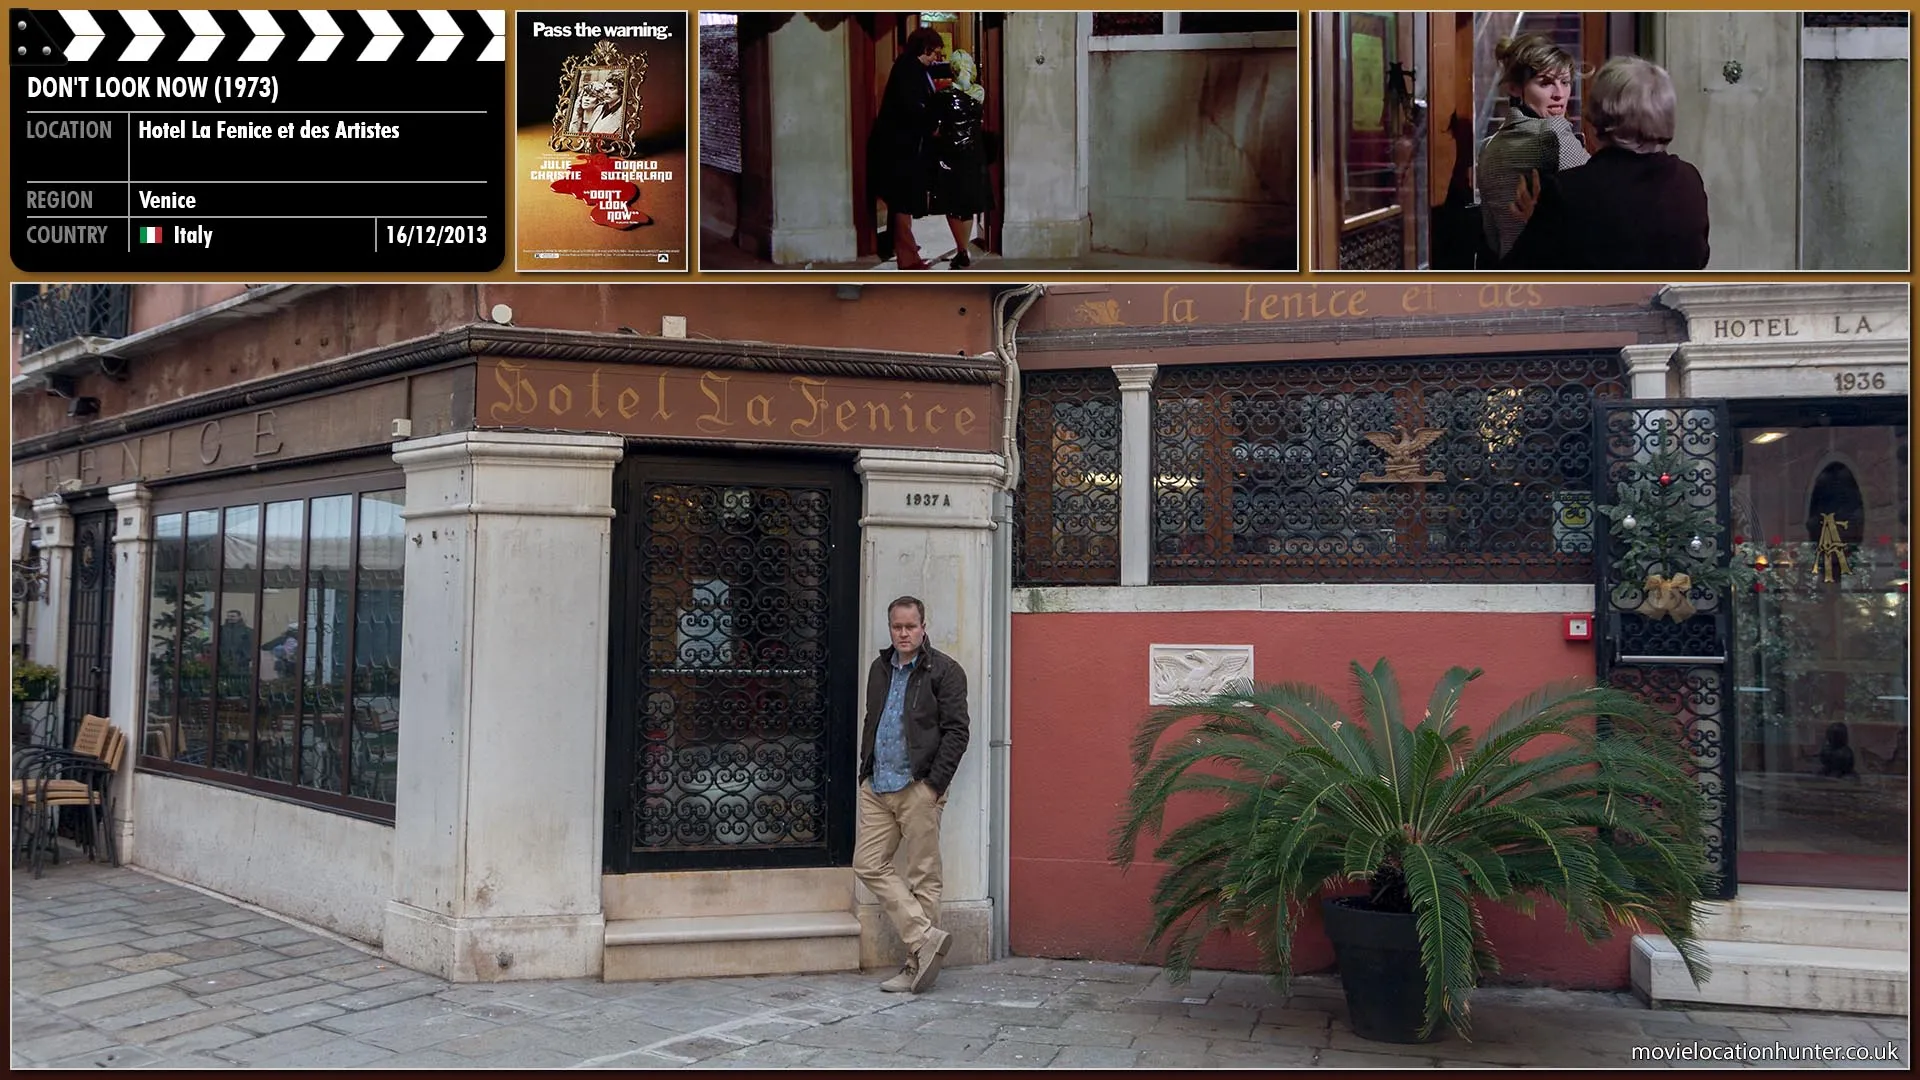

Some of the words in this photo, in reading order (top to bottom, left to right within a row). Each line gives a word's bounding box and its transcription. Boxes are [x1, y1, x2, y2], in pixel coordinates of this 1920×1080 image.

[533, 22, 572, 38] Pass
[573, 22, 602, 38] the
[603, 22, 673, 40] warning.
[540, 160, 572, 170] JULIE
[614, 160, 658, 172] DONALD
[530, 171, 582, 182] CHRISTIE
[601, 171, 673, 183] SUTHERLAND
[600, 200, 628, 212] LOOK
[1160, 285, 1199, 325] la
[1714, 317, 1799, 339] HOTEL
[1834, 314, 1874, 335] LA
[1833, 371, 1887, 393] 1936
[490, 358, 674, 424] Hotel
[695, 369, 777, 434] La
[789, 374, 978, 438] Fenice
[905, 492, 940, 507] 1937
